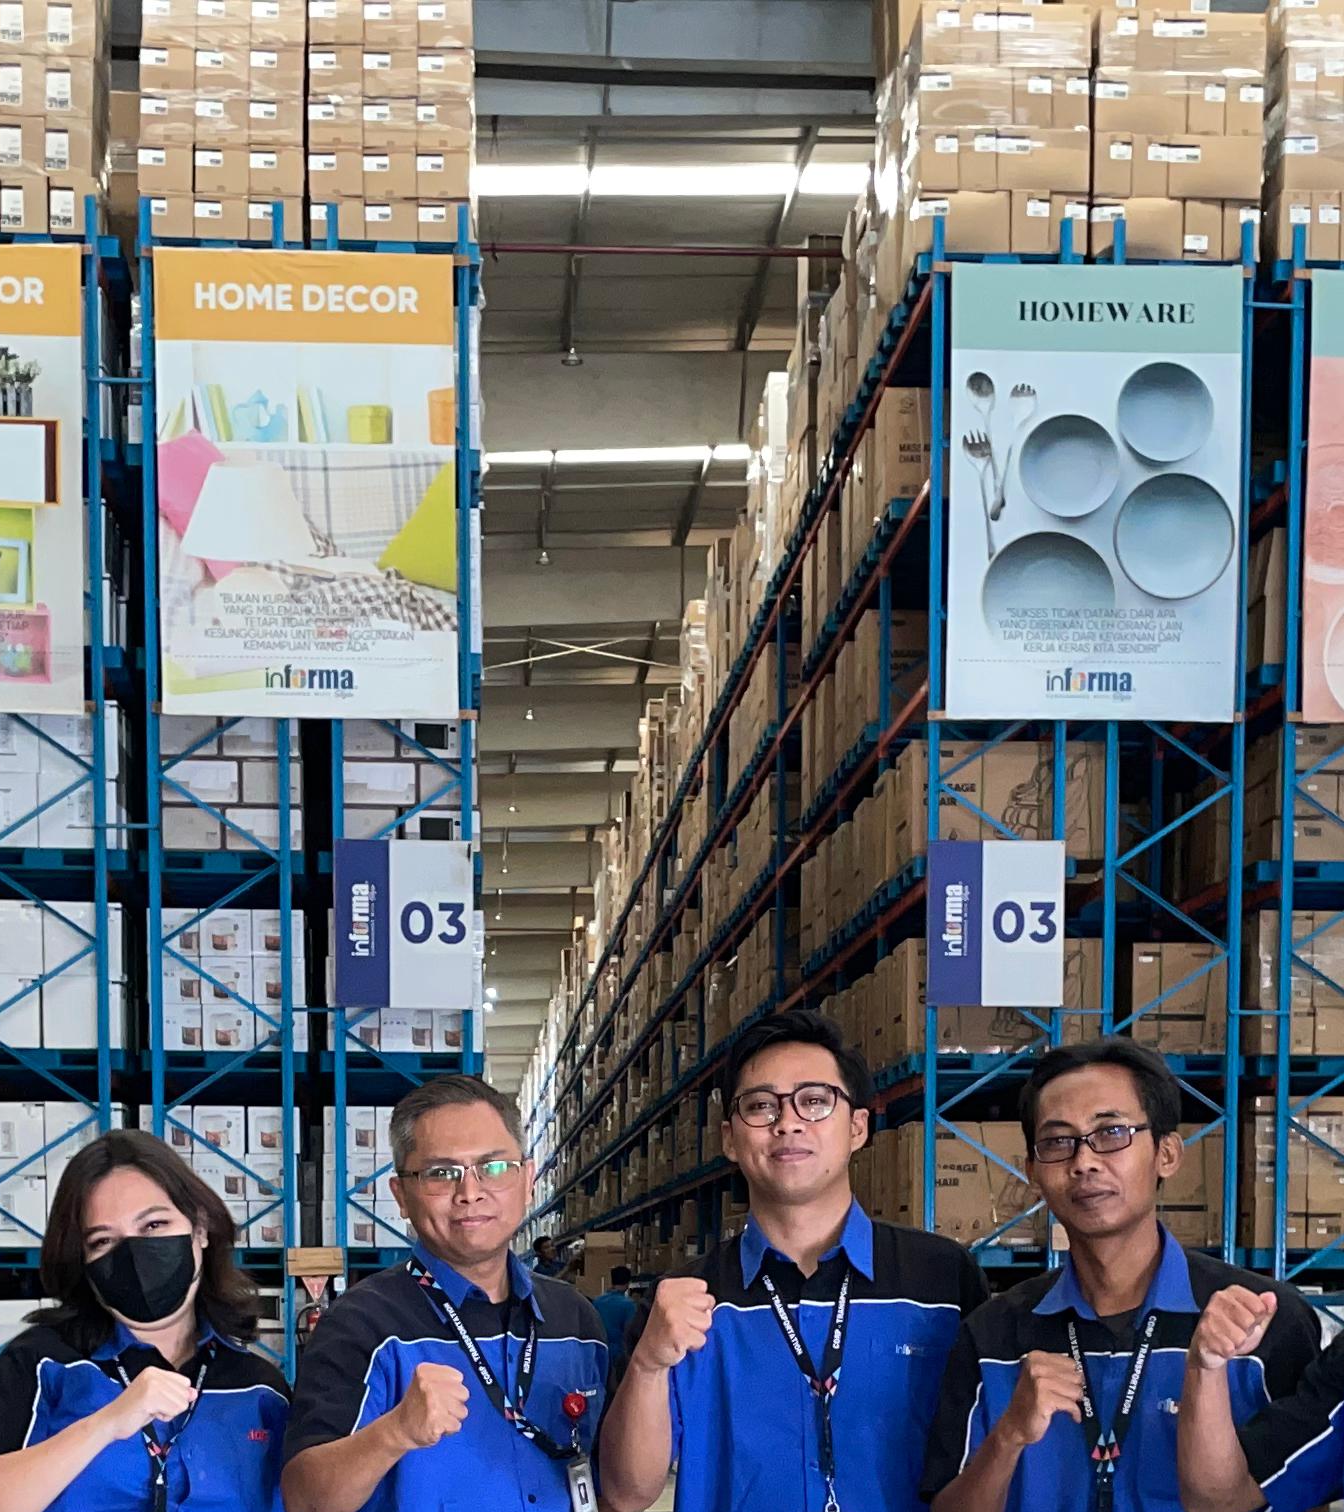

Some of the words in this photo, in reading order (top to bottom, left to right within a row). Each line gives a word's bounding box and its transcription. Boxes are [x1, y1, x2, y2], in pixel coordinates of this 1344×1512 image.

[195, 282, 293, 311] HOME
[302, 284, 419, 313] DECOR
[1019, 300, 1195, 324] HOMEWARE
[223, 604, 254, 616] YANG
[1052, 607, 1080, 618] TIDAK
[1084, 607, 1127, 619] DATANG
[1130, 608, 1154, 619] DARI
[1156, 608, 1177, 619] APA
[204, 628, 288, 640] KESUNGGUHAN
[998, 619, 1026, 630] YANG
[1029, 619, 1083, 631] DIBERIKAN
[1086, 619, 1115, 631] OLEH
[1116, 619, 1156, 632] ORANG
[1003, 630, 1024, 641] TAPI
[1026, 630, 1070, 641] DATANG
[1072, 631, 1096, 642] DARI
[1099, 631, 1155, 643] KEYAKINAN
[1158, 632, 1181, 643] DAN
[243, 640, 311, 652] KEMAMPUAN
[314, 641, 344, 652] YANG
[1023, 642, 1055, 653] KERJA
[1058, 642, 1090, 653] KERAS
[1093, 642, 1115, 653] KITA
[264, 663, 355, 689] informa
[1045, 666, 1133, 693] informa
[348, 882, 369, 957] informa
[400, 901, 467, 945] 03
[942, 883, 963, 957] informa
[992, 901, 1057, 944] 03
[443, 1302, 481, 1363] TRANSPORTATION
[772, 1294, 803, 1356] TRANSPORTATION
[1144, 1315, 1157, 1338] CORP
[832, 1328, 842, 1350] CORP
[478, 1365, 493, 1385] CORP
[1121, 1343, 1150, 1415] TRANSPORTATION
